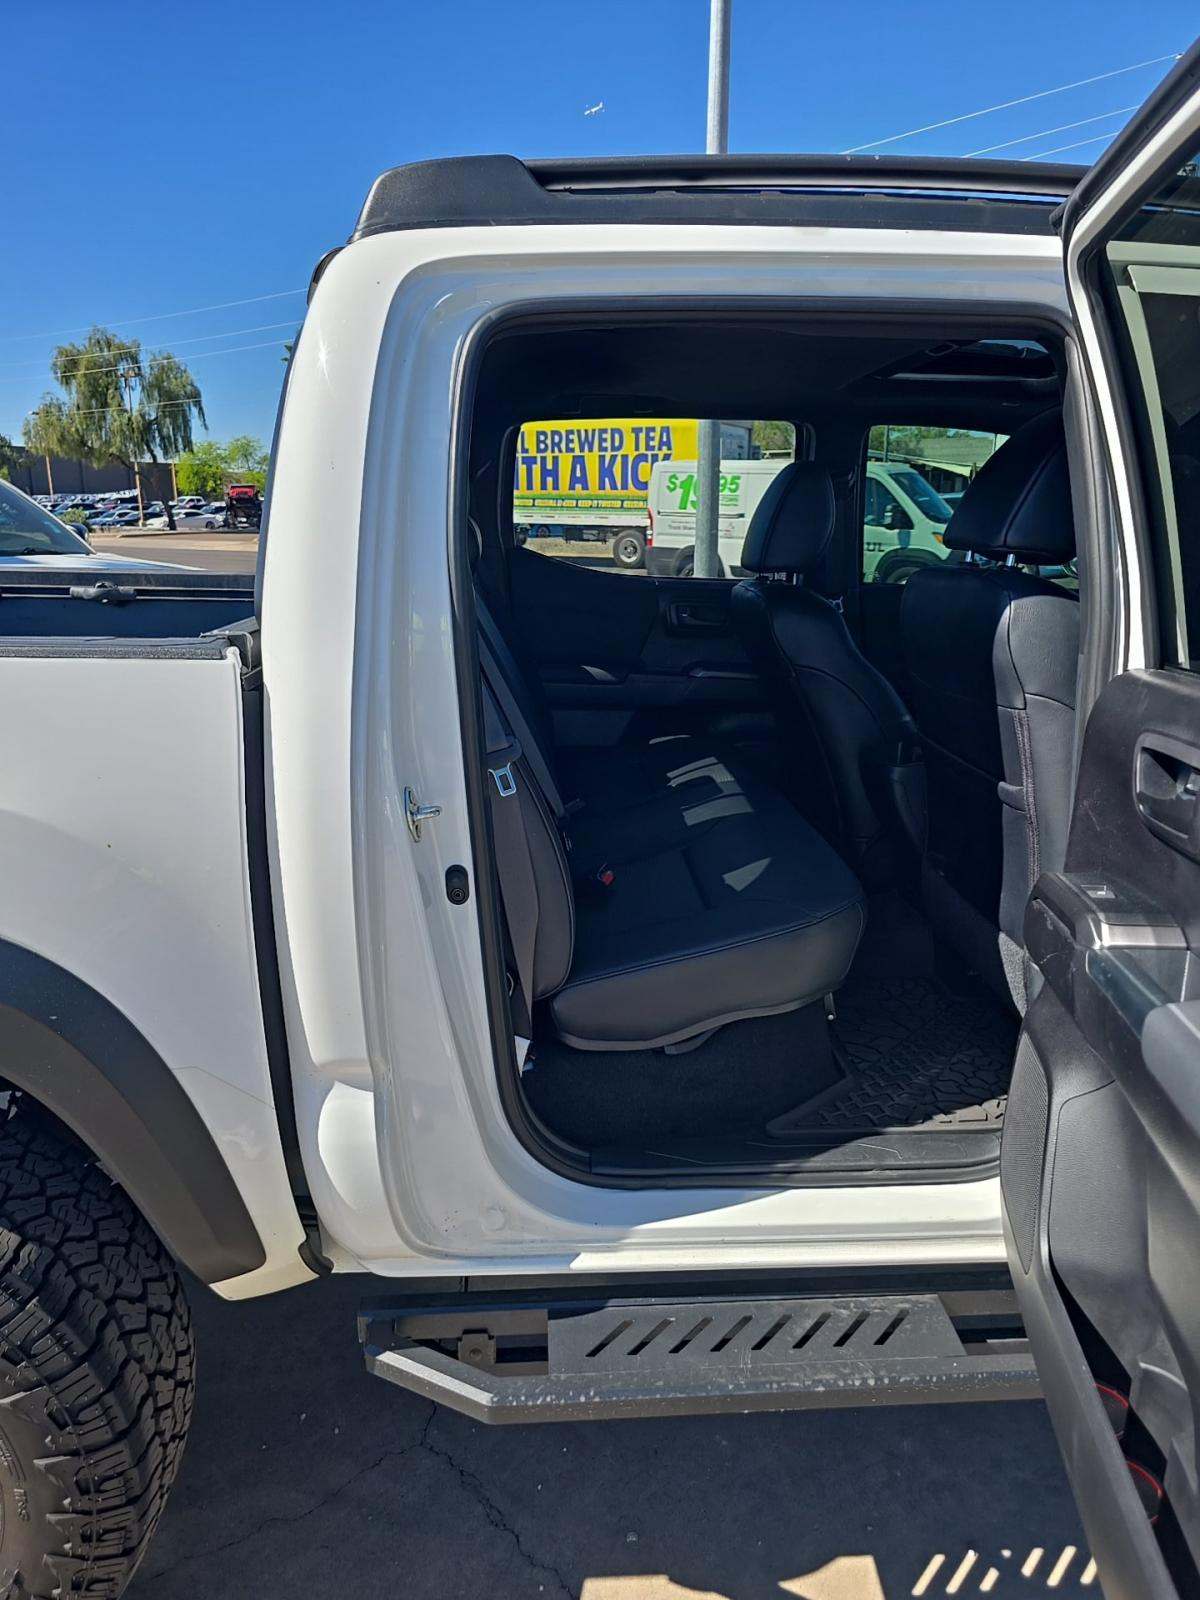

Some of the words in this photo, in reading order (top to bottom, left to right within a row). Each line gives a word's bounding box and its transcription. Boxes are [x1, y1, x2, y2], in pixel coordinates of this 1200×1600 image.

[536, 428, 624, 454] BREWED
[631, 426, 673, 452] TEA
[568, 455, 590, 491] A
[598, 453, 673, 491] KIC
